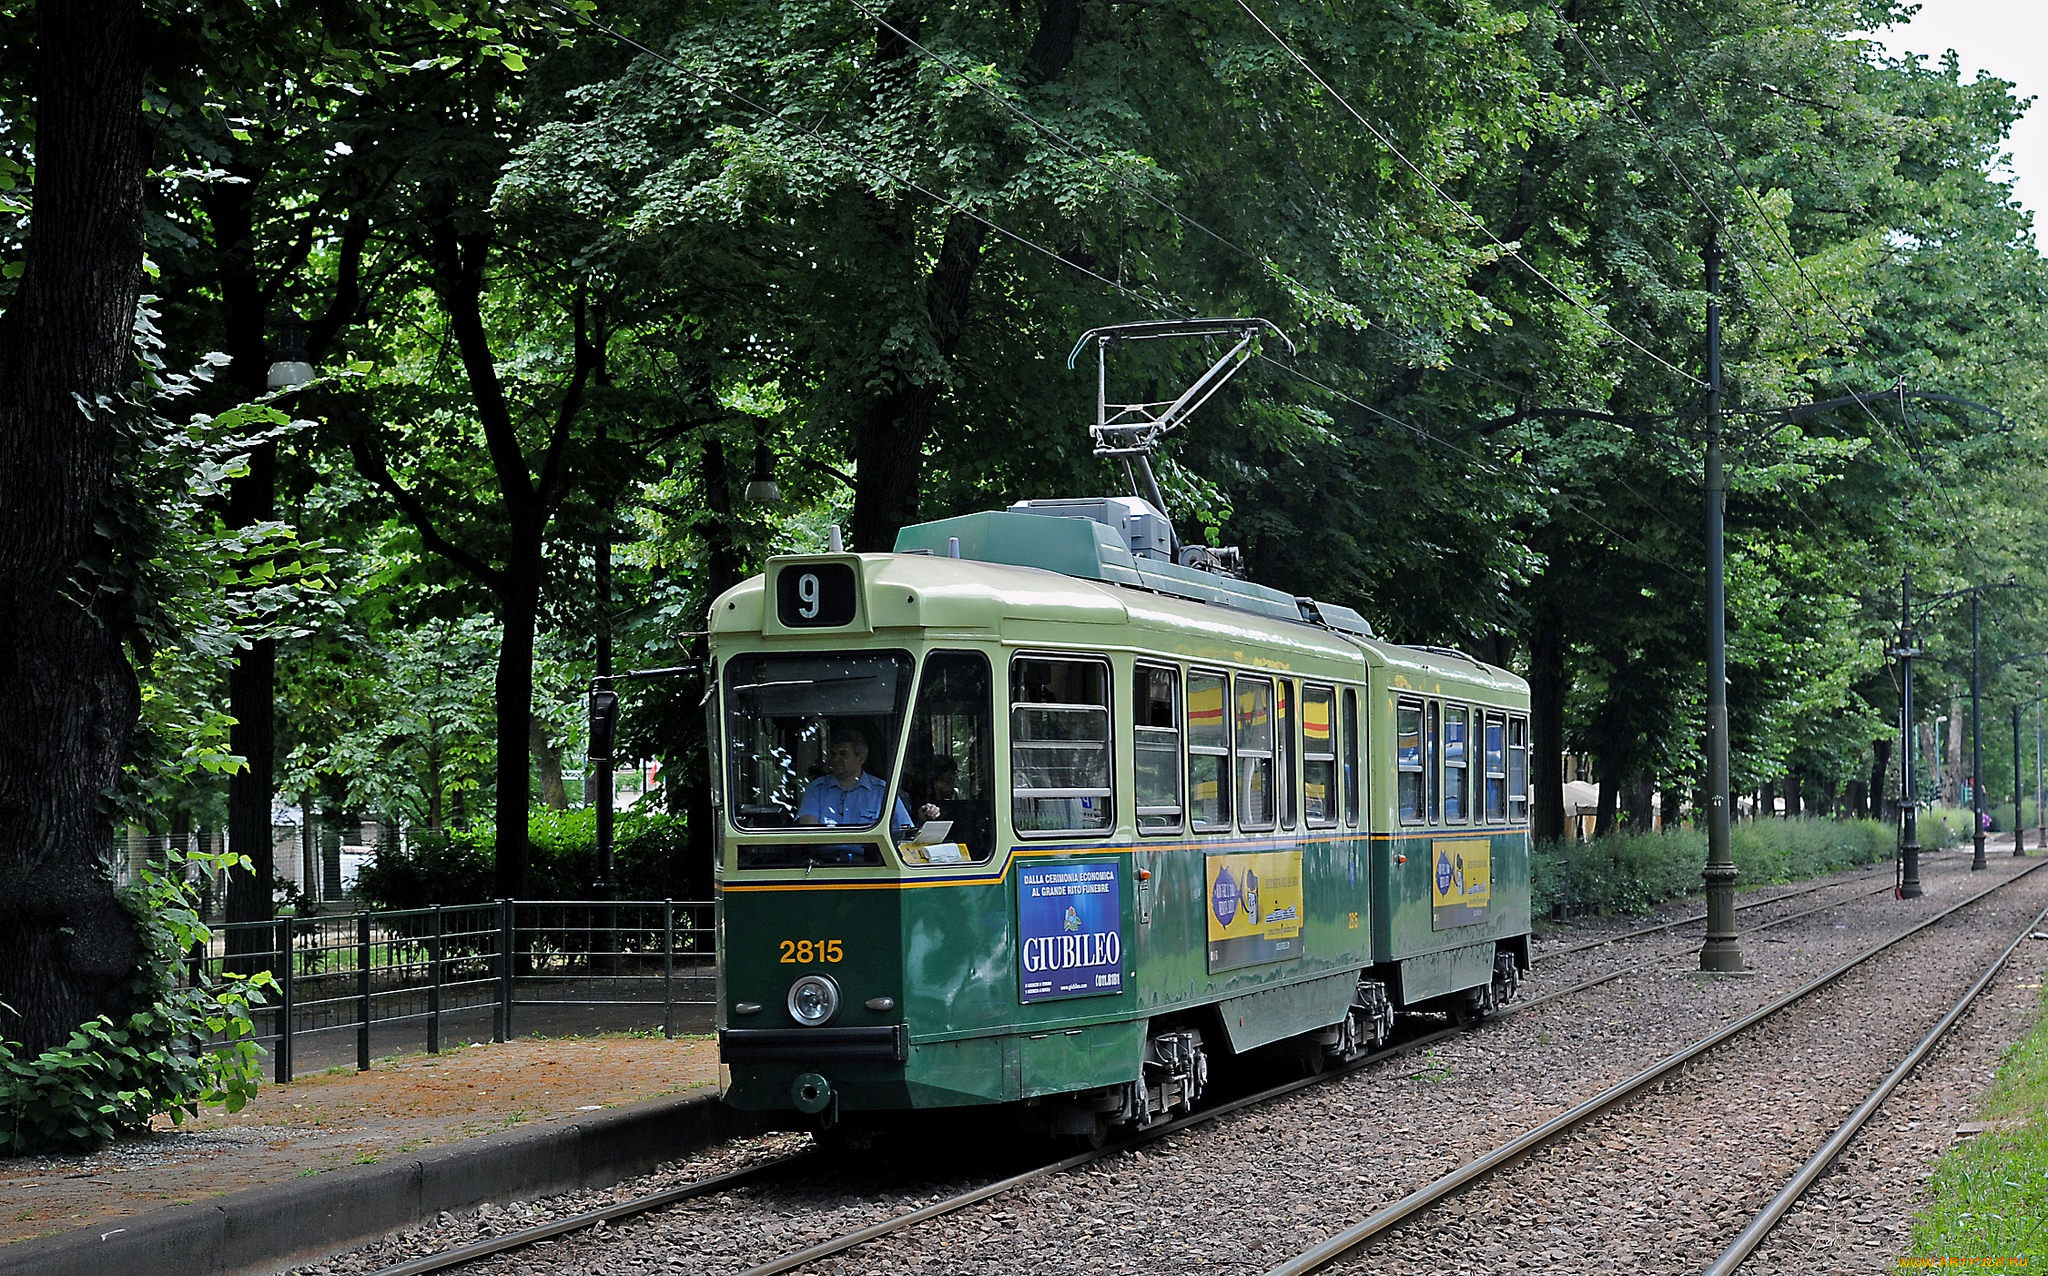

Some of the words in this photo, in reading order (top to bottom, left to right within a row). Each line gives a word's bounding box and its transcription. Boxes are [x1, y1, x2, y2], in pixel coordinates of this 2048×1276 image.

[799, 573, 819, 619] 9
[1024, 875, 1044, 885] DALLA
[1045, 873, 1078, 884] CERIMONIA
[1080, 871, 1114, 882] ECONOMICA
[1032, 887, 1040, 897] AL
[1041, 885, 1066, 896] GRANDE
[1067, 884, 1081, 895] RITO
[1082, 883, 1109, 894] FUNEBRE
[780, 940, 844, 963] 2815
[1023, 931, 1120, 972] GIUBILEO
